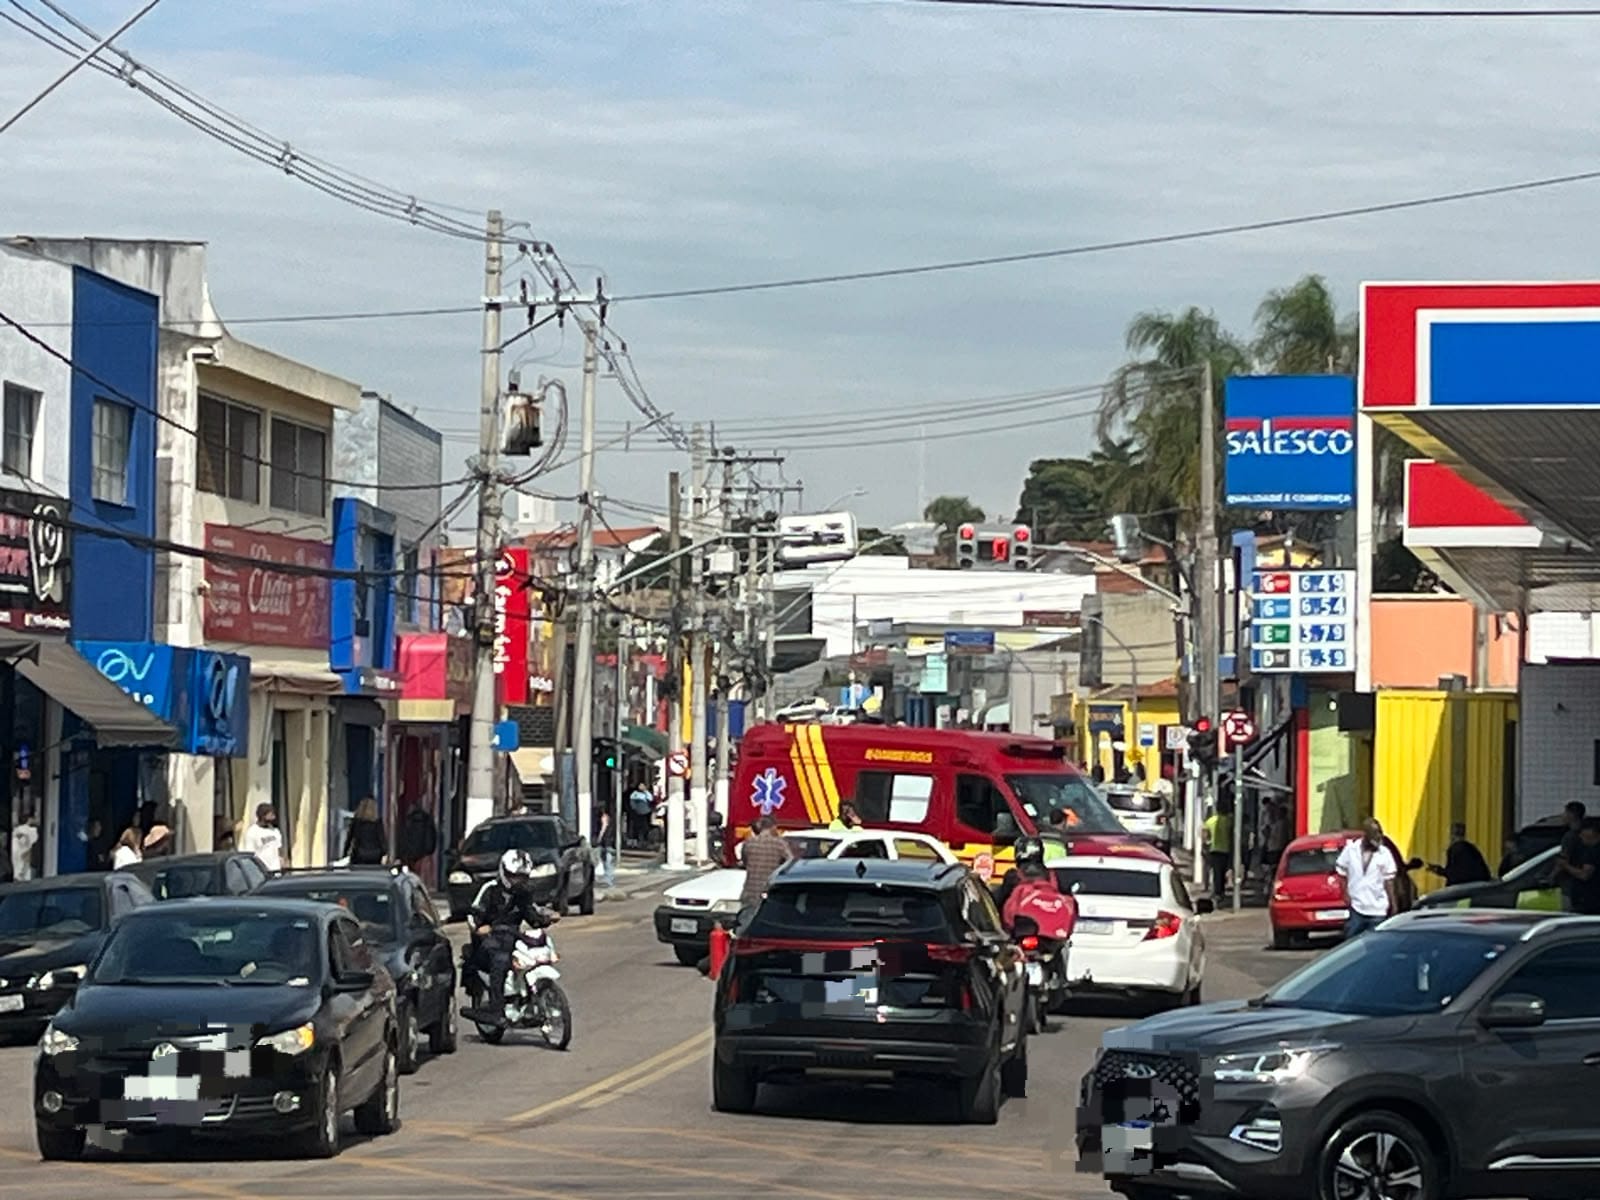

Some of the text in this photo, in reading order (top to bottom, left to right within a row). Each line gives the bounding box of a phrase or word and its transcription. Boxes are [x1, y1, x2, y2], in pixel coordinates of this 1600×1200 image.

[1263, 574, 1275, 592] G
[1263, 600, 1274, 616] G
[1263, 625, 1273, 642] E
[1263, 651, 1274, 667] D
